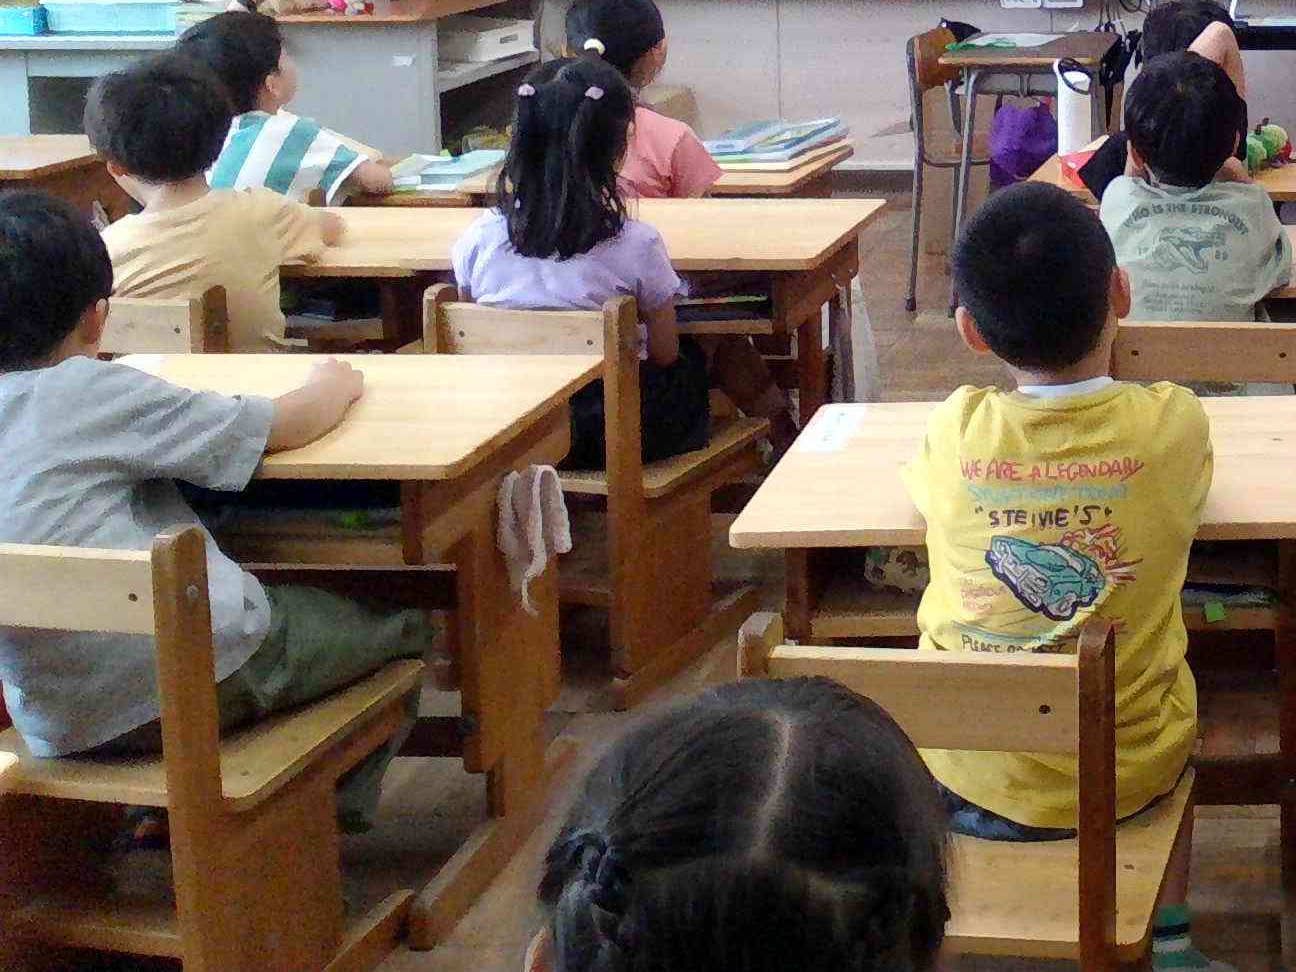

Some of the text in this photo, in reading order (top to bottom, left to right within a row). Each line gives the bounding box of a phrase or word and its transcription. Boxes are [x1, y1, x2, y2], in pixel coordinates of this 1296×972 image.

[1152, 203, 1164, 214] IS
[1166, 202, 1187, 214] THE
[960, 459, 982, 479] WE
